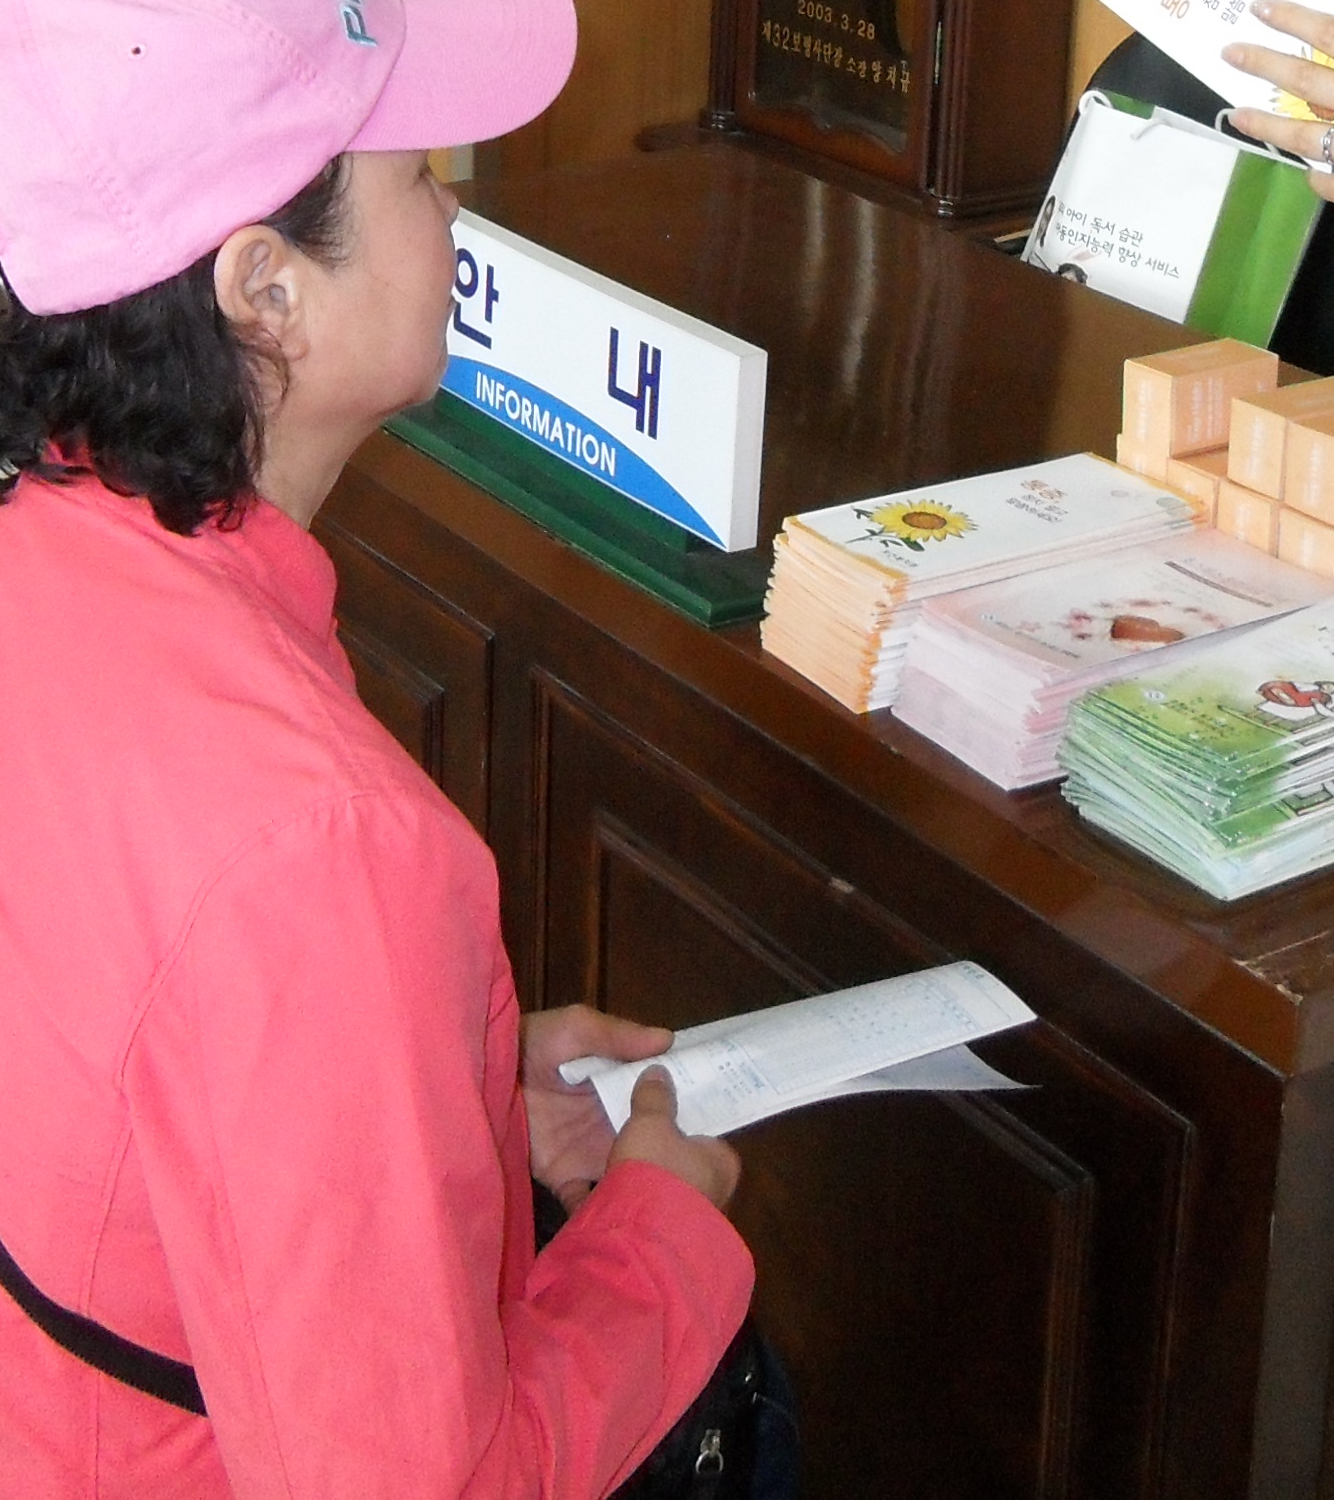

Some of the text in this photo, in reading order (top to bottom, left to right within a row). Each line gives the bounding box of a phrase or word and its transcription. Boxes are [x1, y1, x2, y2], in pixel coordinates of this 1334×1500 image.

[1090, 216, 1116, 236] 독서
[1118, 227, 1144, 248] 습관
[1118, 246, 1142, 268] 향상
[1145, 257, 1180, 279] 서비스
[475, 370, 616, 478] INFORMATION
